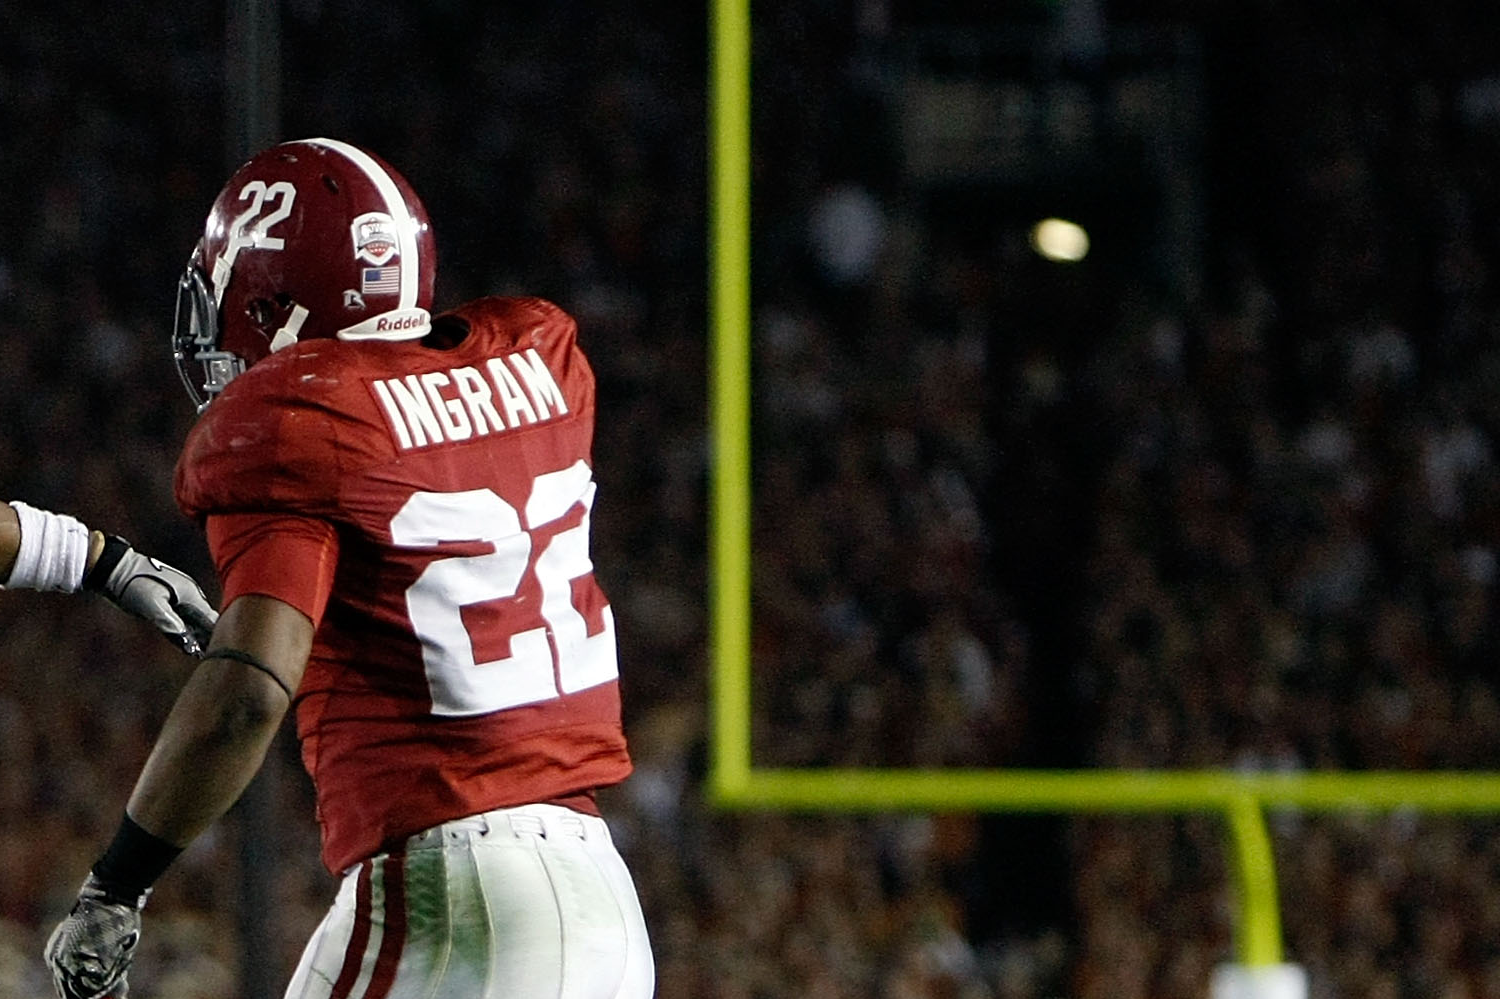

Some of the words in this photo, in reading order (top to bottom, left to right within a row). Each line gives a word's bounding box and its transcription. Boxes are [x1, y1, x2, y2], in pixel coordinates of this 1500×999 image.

[229, 180, 297, 250] 22
[376, 312, 426, 332] Riddell
[373, 348, 569, 450] INGRAM
[389, 458, 619, 718] 22
